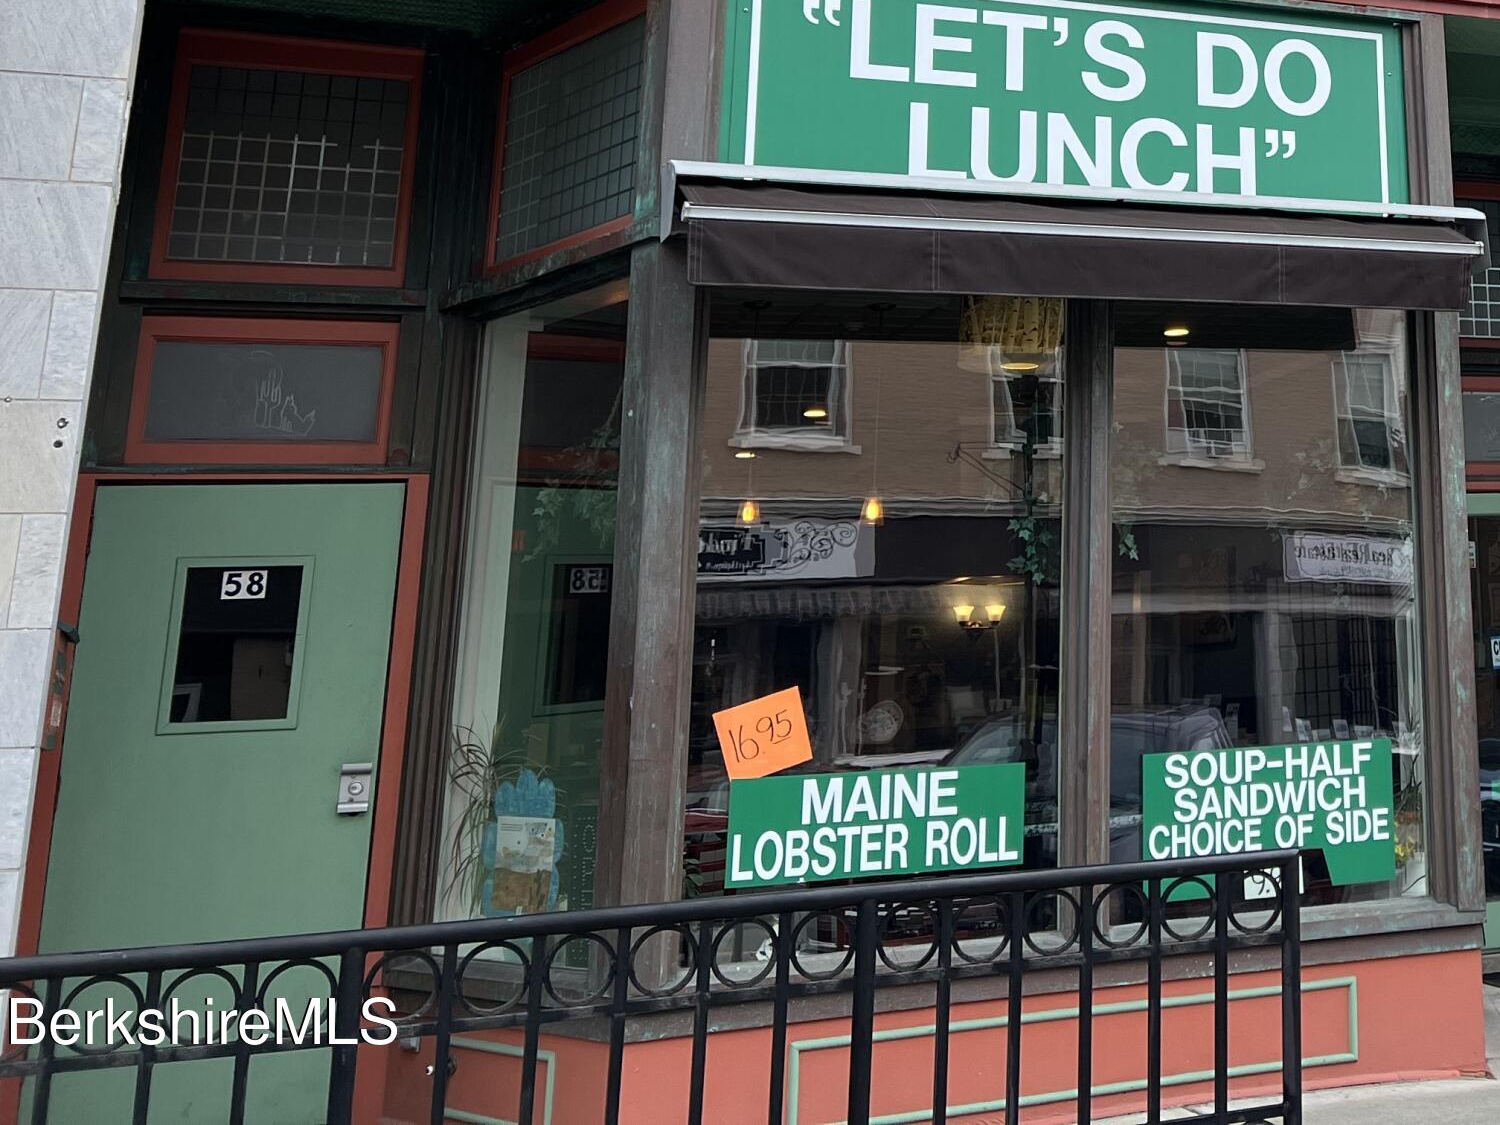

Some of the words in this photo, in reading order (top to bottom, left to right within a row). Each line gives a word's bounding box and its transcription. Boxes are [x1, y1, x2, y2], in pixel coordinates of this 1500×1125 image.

[1197, 31, 1331, 117] DO
[224, 572, 264, 597] 58
[1164, 742, 1372, 789] SOUP-HALF
[801, 771, 958, 825] MAINE
[1174, 776, 1366, 823] SANDWICH
[731, 823, 909, 881] LOBSTER
[925, 816, 1018, 866] ROLL
[1149, 818, 1262, 860] CHOICE
[1275, 814, 1314, 849] OF
[1326, 807, 1389, 845] SIDE
